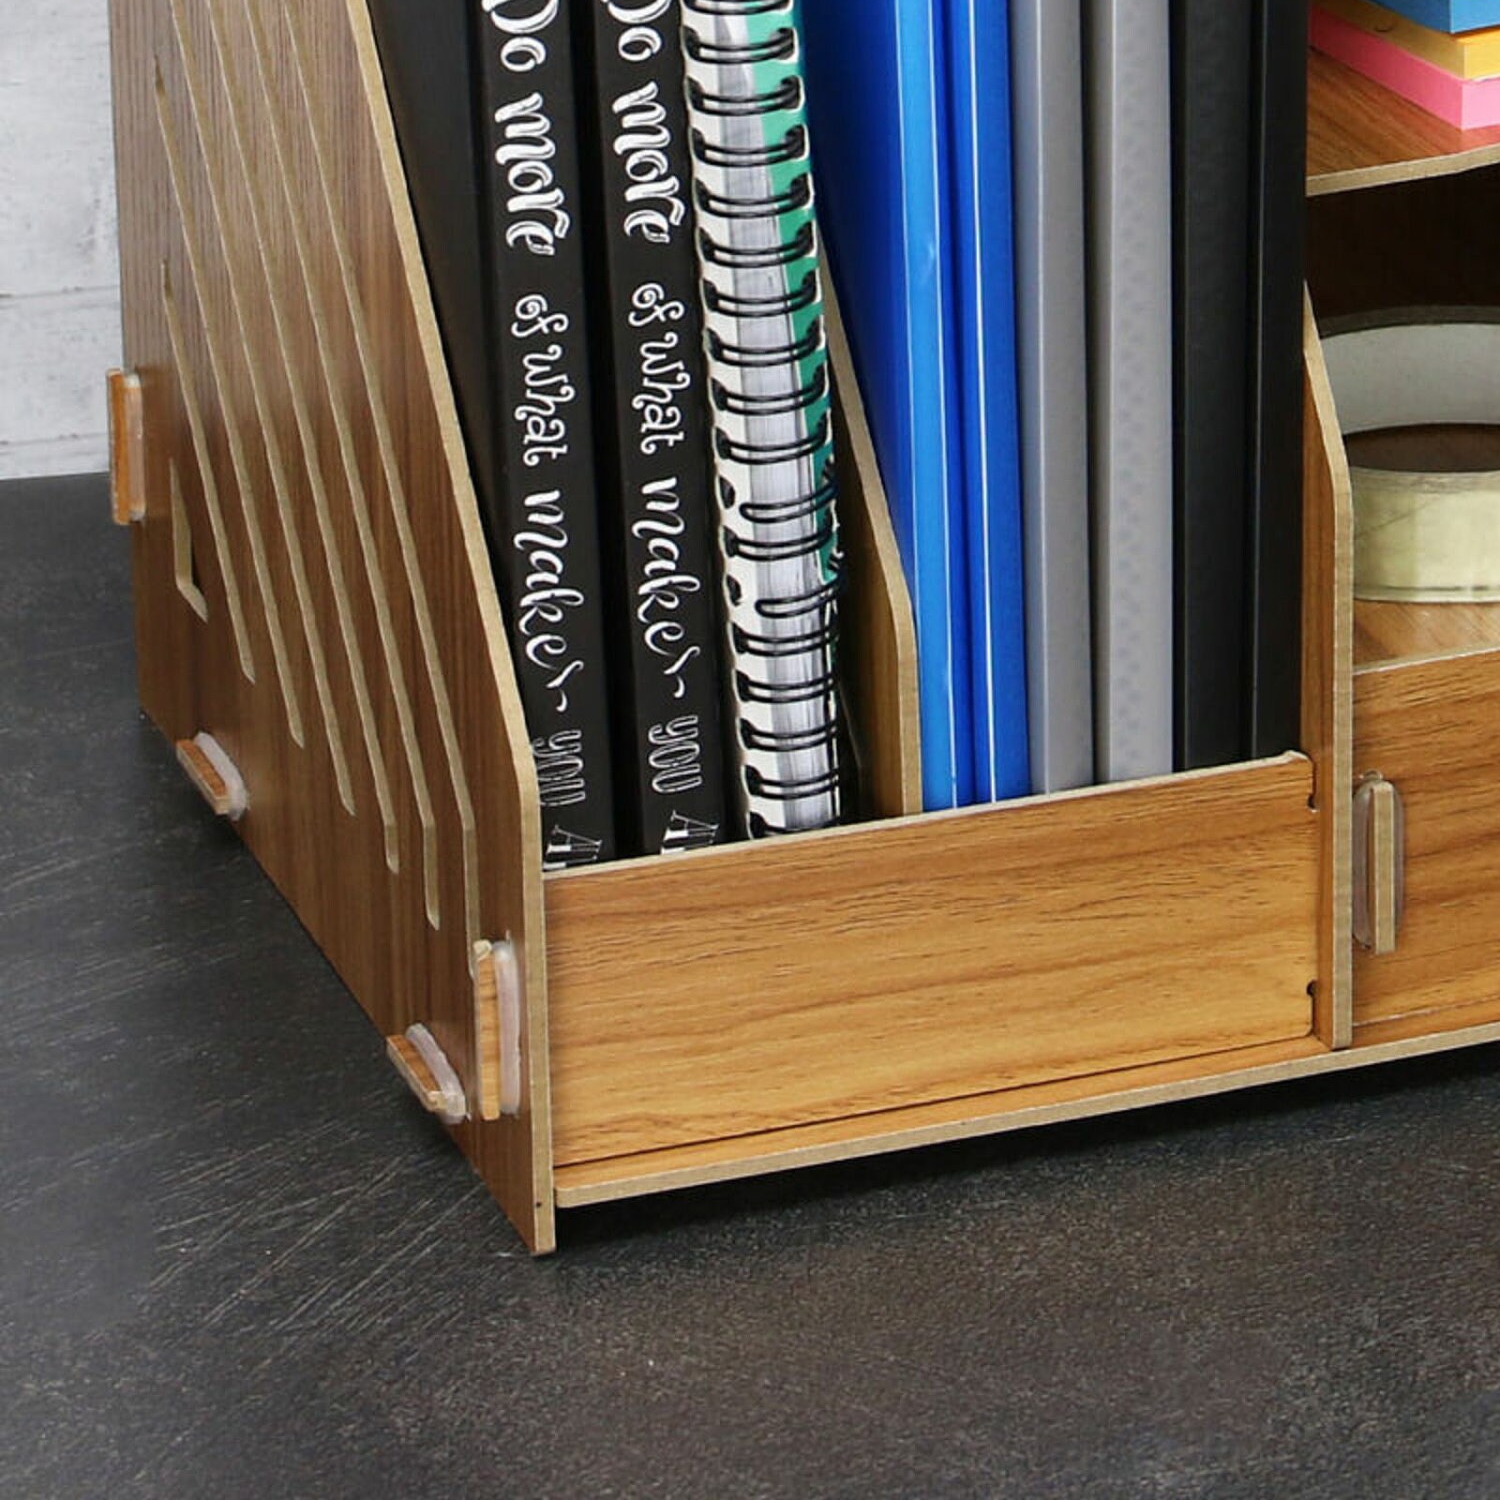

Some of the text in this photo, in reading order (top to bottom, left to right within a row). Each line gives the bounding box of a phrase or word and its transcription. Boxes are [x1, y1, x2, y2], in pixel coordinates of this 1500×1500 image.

[494, 92, 570, 256] more
[612, 80, 686, 244] more
[514, 344, 576, 467] what
[631, 331, 691, 455] what
[513, 489, 584, 713] makes
[631, 476, 700, 698] makes
[532, 729, 586, 807] you
[647, 714, 702, 794] you
